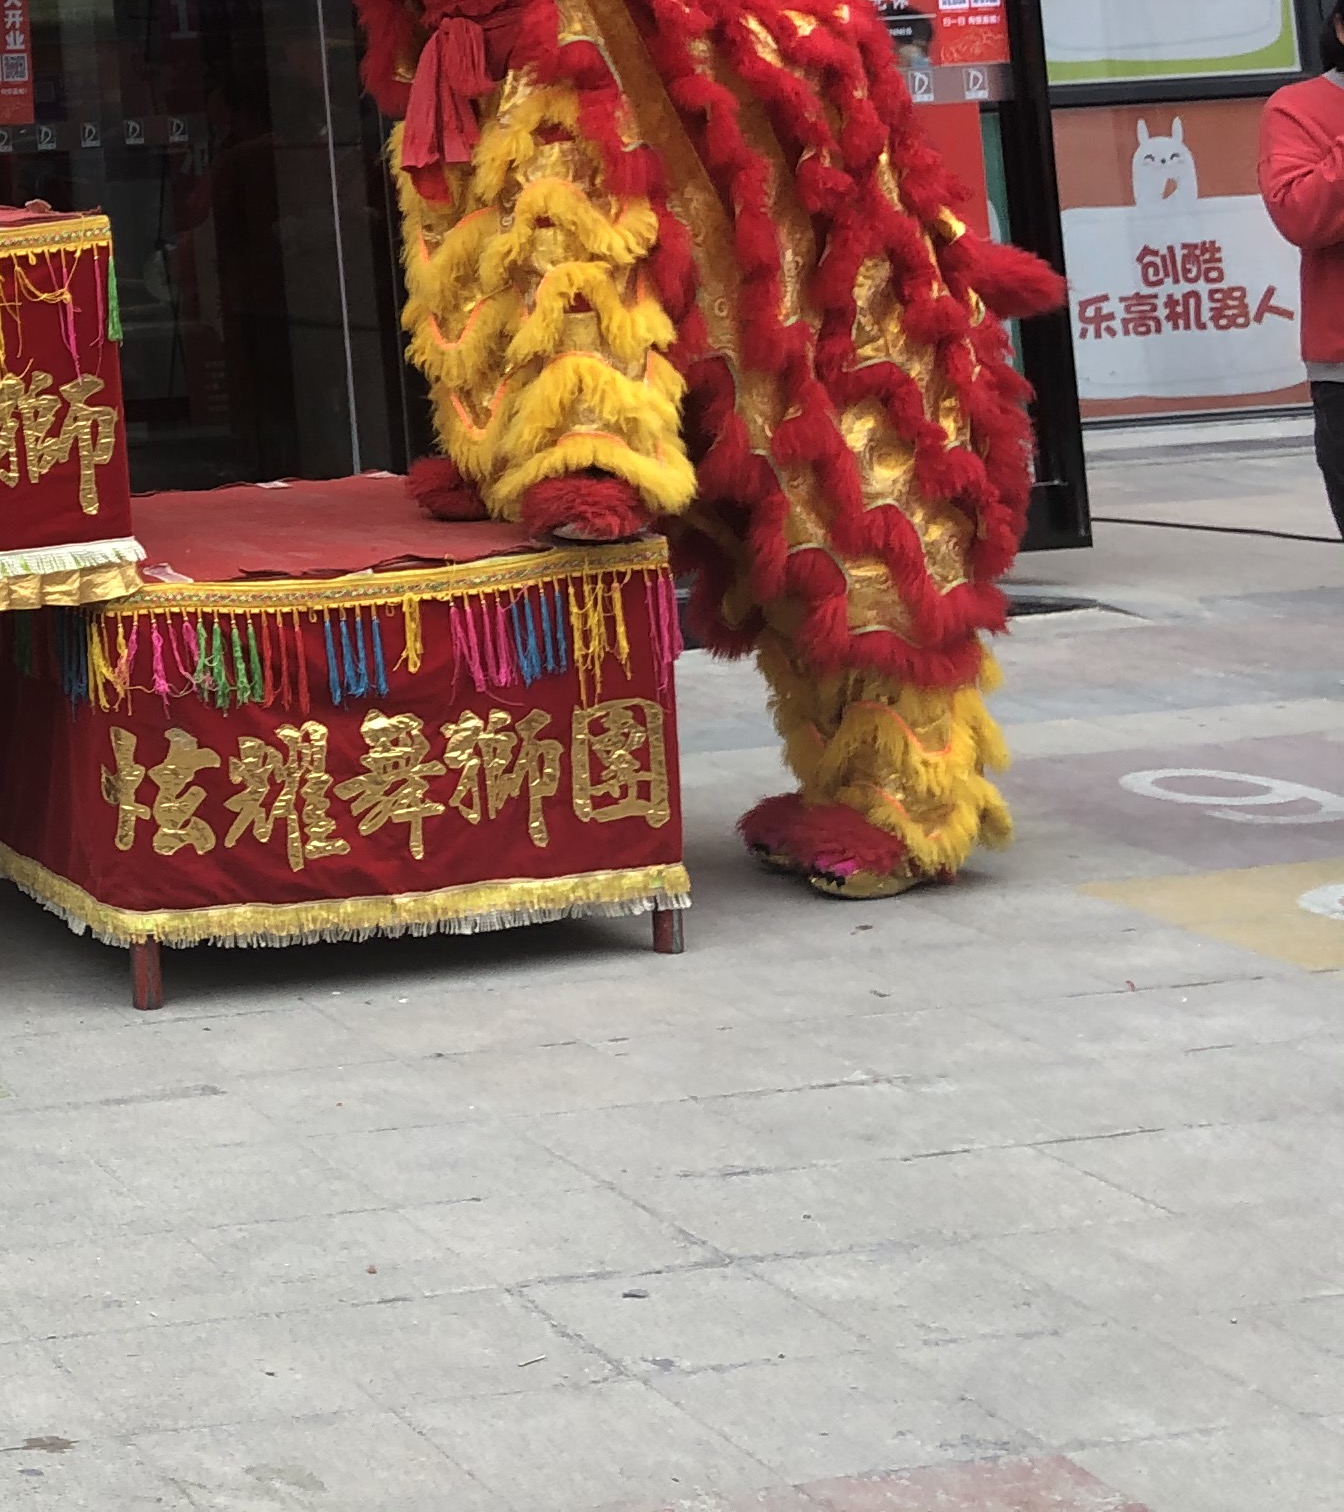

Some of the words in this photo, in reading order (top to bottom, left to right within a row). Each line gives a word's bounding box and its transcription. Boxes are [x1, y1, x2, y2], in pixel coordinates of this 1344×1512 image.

[1135, 239, 1225, 287] 创酷
[1077, 284, 1295, 340] 乐高机器人
